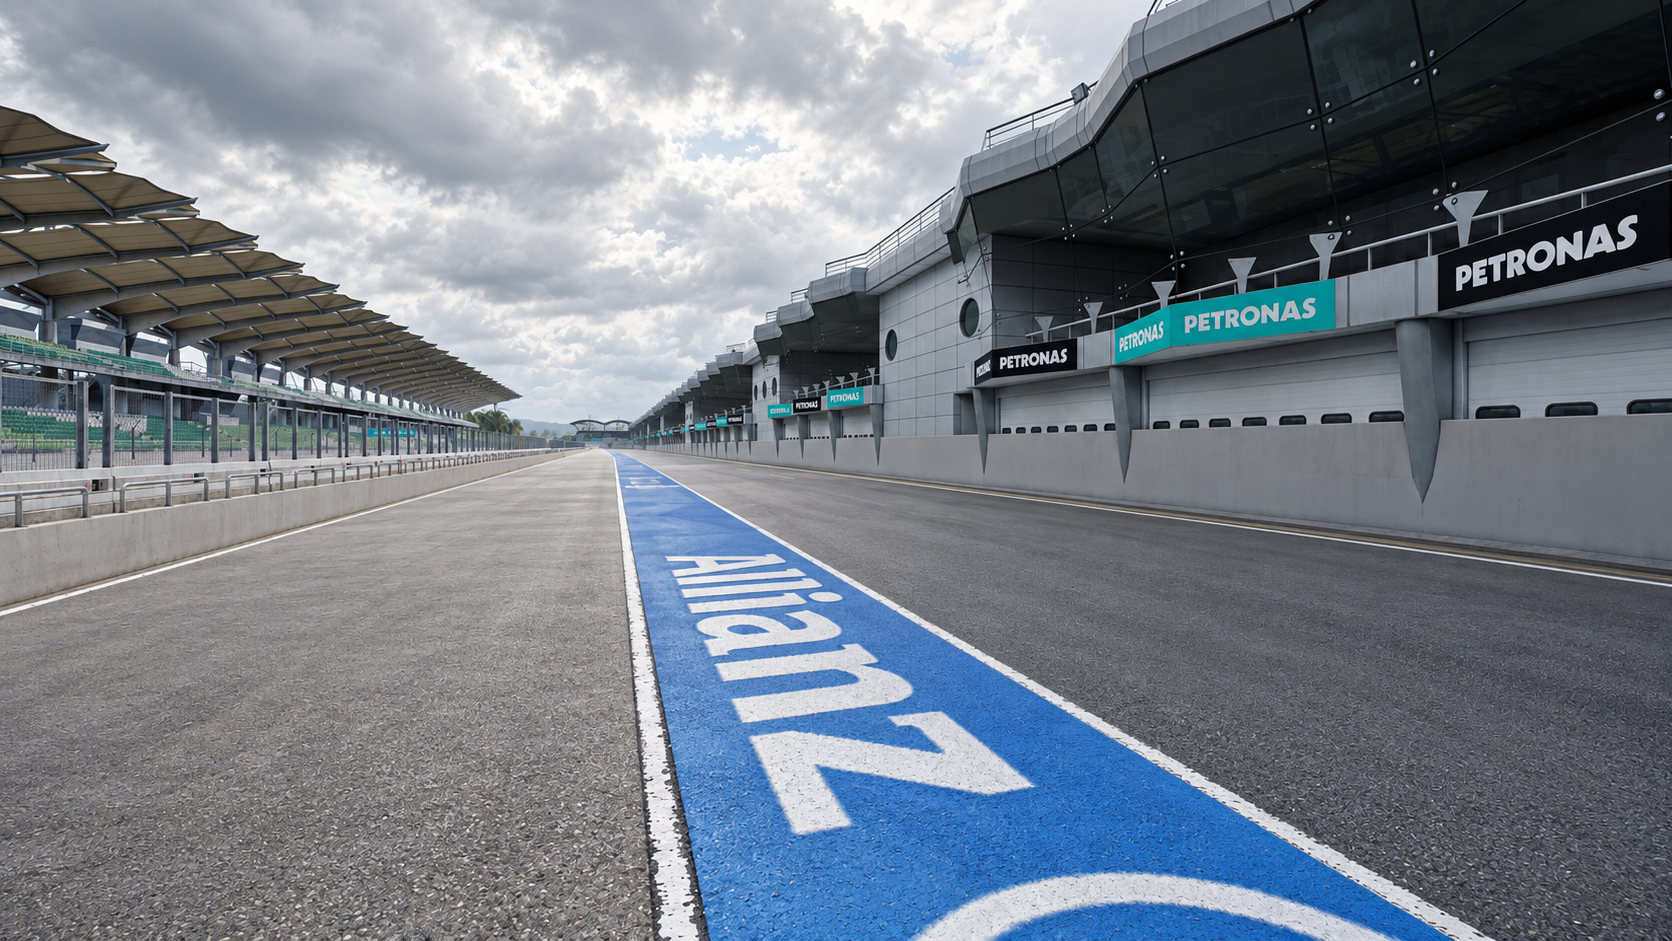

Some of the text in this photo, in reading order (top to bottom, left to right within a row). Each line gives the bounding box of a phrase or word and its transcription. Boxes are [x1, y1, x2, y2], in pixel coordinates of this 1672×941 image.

[1455, 214, 1638, 292] PETRONAS
[1184, 297, 1316, 334] PETRONAS
[1119, 320, 1164, 353] PETRONAS
[999, 348, 1067, 370] PETRONAS
[665, 553, 1036, 835] Allianz
